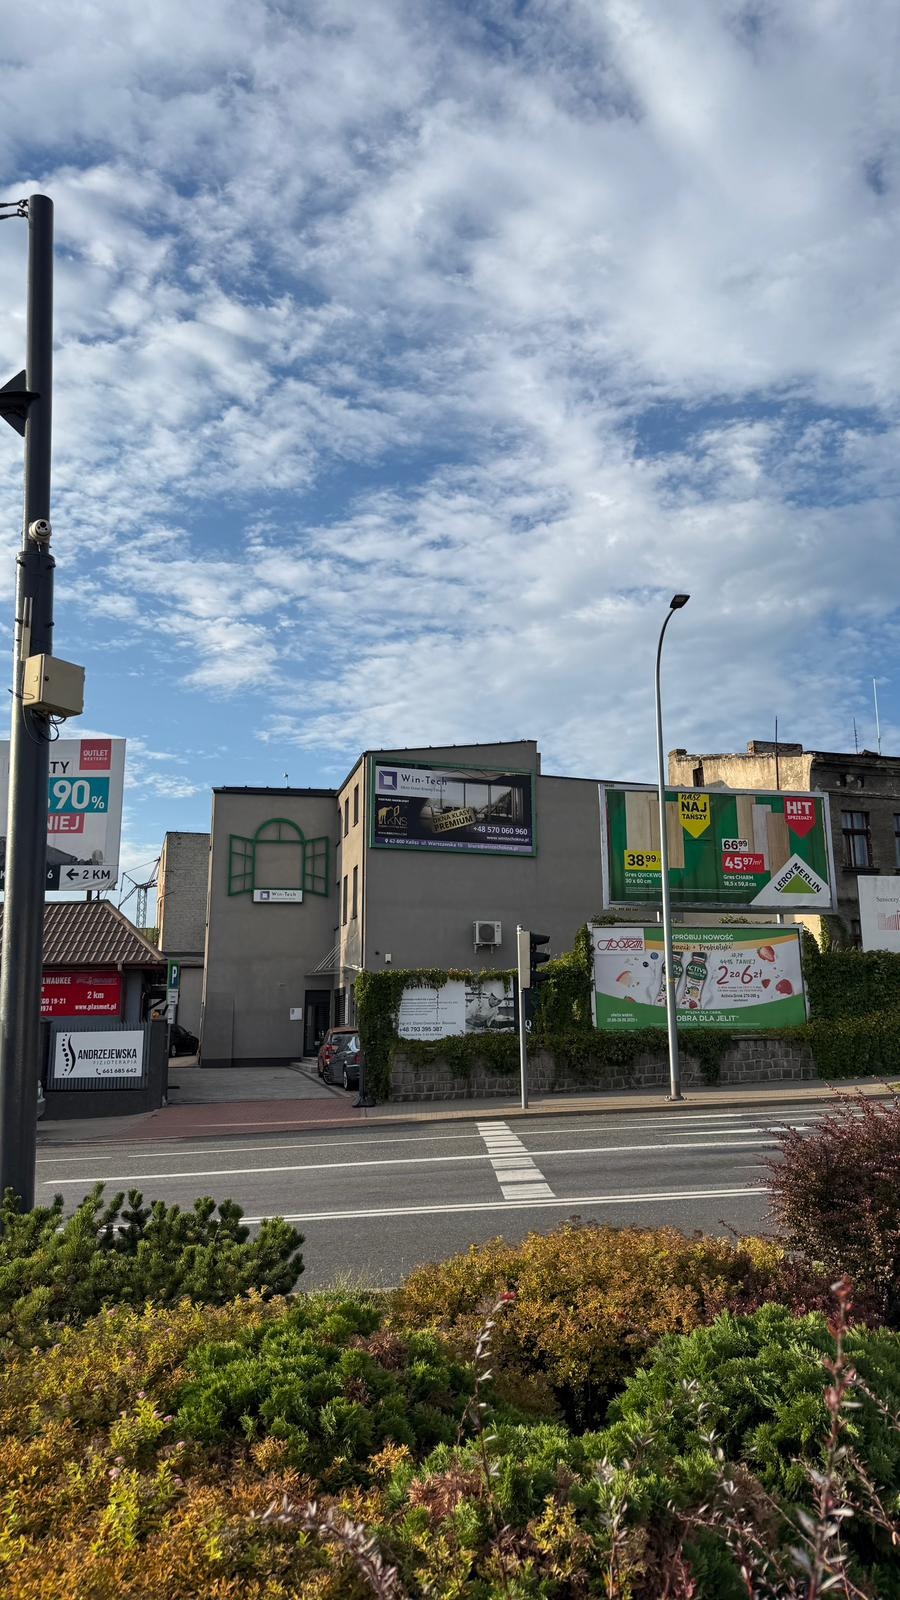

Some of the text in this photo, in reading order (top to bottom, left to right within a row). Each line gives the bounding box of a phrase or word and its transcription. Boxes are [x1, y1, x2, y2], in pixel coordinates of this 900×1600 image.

[48, 761, 70, 774] TY
[401, 774, 448, 786] Win-Tech
[681, 802, 707, 812] NAJ
[452, 810, 471, 818] KLASY
[434, 815, 473, 831] PREMIUM
[83, 870, 89, 879] 2
[92, 870, 111, 879] KM
[774, 862, 822, 893] LEROY MERLIN
[172, 966, 178, 984] P
[716, 965, 730, 985] 2
[741, 965, 753, 984] 6
[87, 991, 93, 999] 2
[93, 991, 104, 999] km
[75, 1003, 117, 1011] www.plasmet.pl
[77, 1048, 137, 1060] ANDRZEJEWSKA
